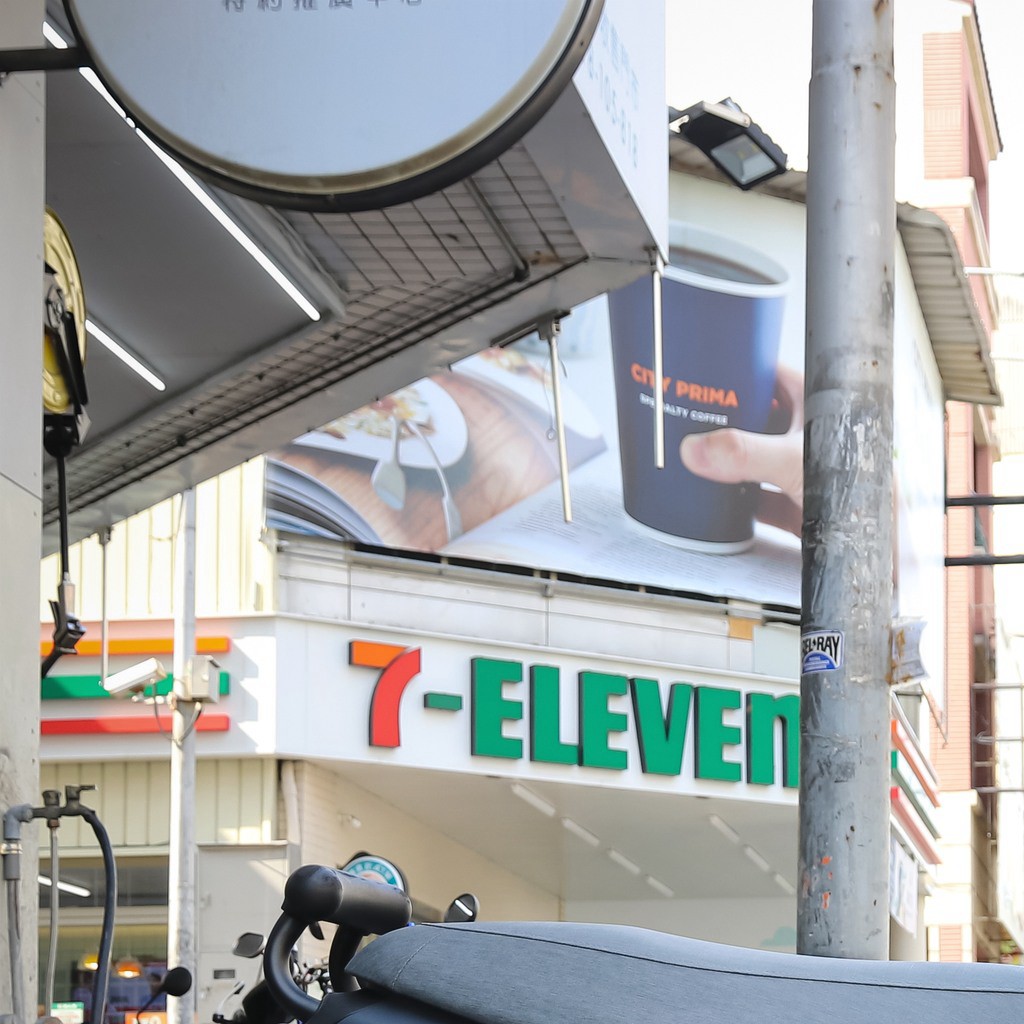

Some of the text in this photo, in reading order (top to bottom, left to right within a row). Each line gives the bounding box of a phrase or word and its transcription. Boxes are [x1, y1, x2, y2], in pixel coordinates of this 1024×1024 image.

[639, 392, 729, 426] SPEALTY COFFEE
[675, 379, 739, 408] PRIMA
